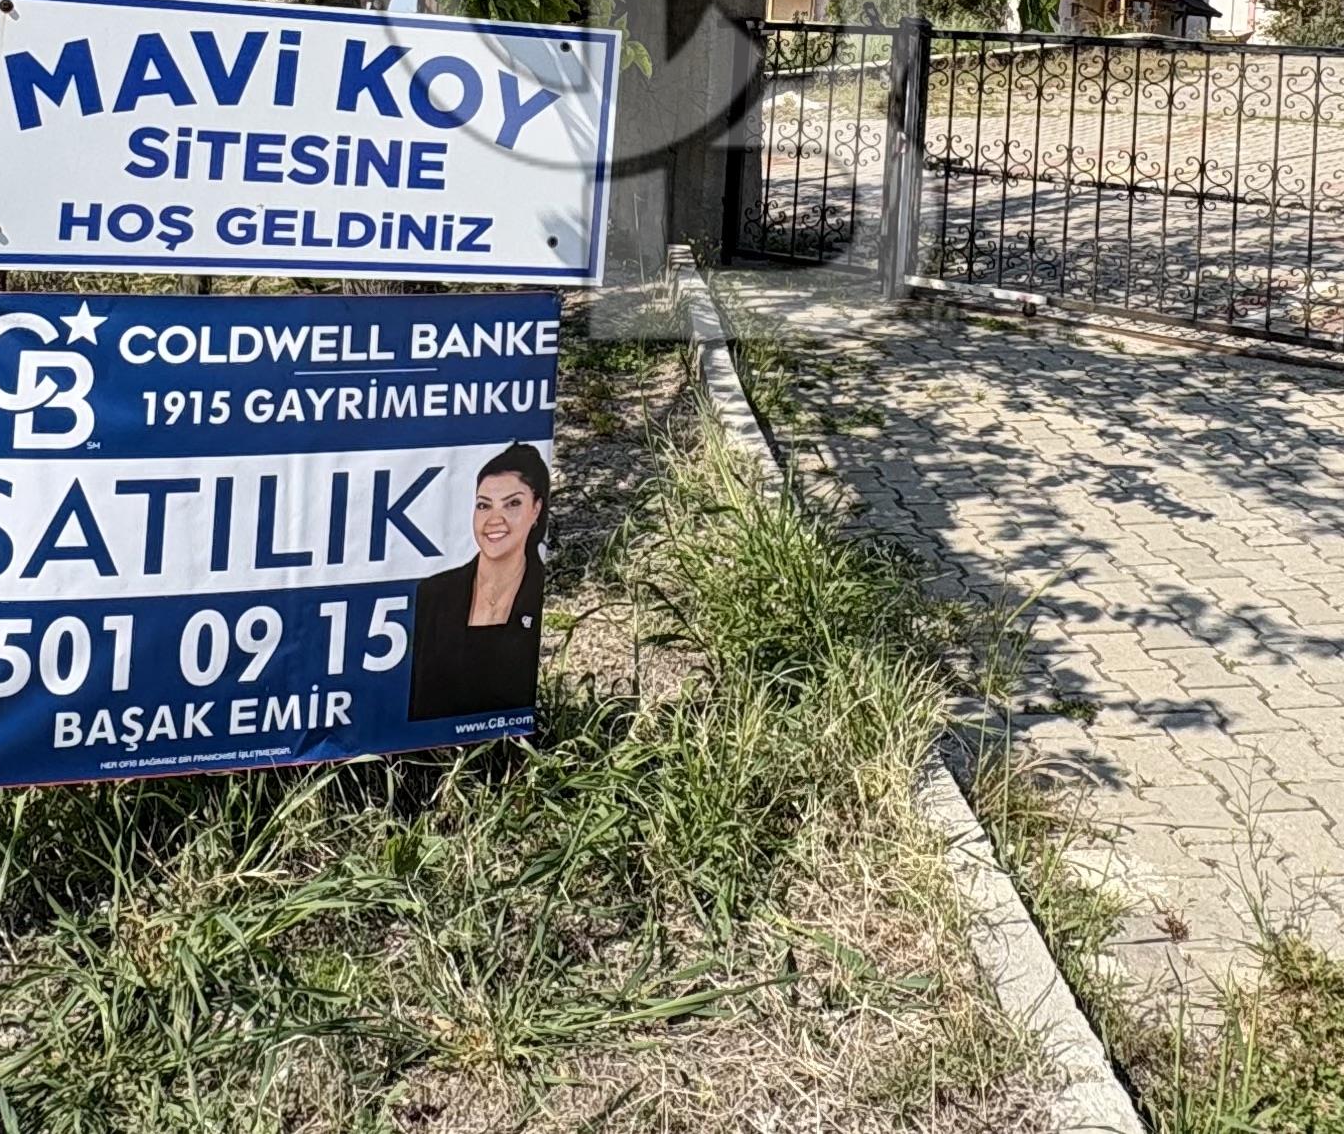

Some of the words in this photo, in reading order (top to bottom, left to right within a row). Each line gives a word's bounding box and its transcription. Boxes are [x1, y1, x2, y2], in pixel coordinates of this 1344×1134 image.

[337, 39, 561, 150] KOY
[57, 202, 195, 251] HOŞ
[119, 324, 395, 365] COLDWELL
[143, 390, 231, 426] 1915
[179, 605, 283, 687] 09
[320, 596, 409, 676] 15
[54, 701, 216, 752] BAŞAK
[229, 684, 353, 736] EMİR
[455, 715, 535, 734] www.CB.com
